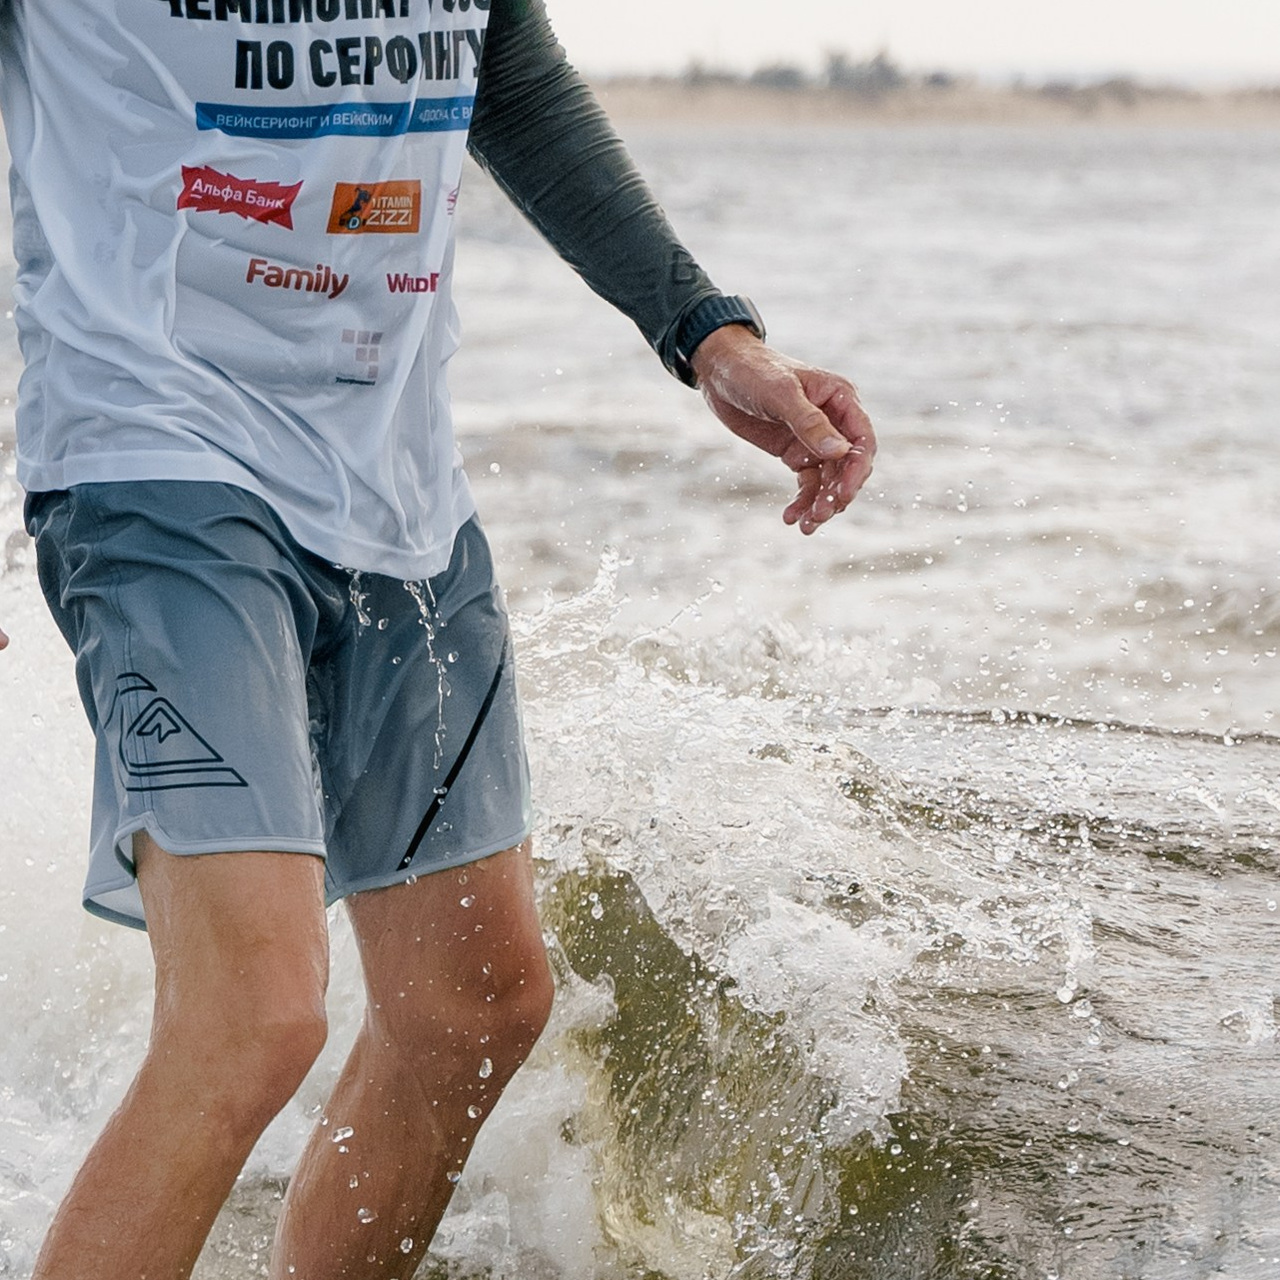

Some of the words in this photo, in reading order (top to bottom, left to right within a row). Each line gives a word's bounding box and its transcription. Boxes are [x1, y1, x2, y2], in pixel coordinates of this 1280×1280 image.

[234, 38, 295, 90] ПО
[308, 28, 487, 88] СЕРФИНГУ
[216, 113, 318, 130] ВЕЙКСЕРИФНГ
[320, 115, 330, 128] И
[451, 106, 459, 120] С
[190, 178, 243, 203] Альфа
[245, 189, 286, 209] Банк
[245, 257, 350, 300] Family
